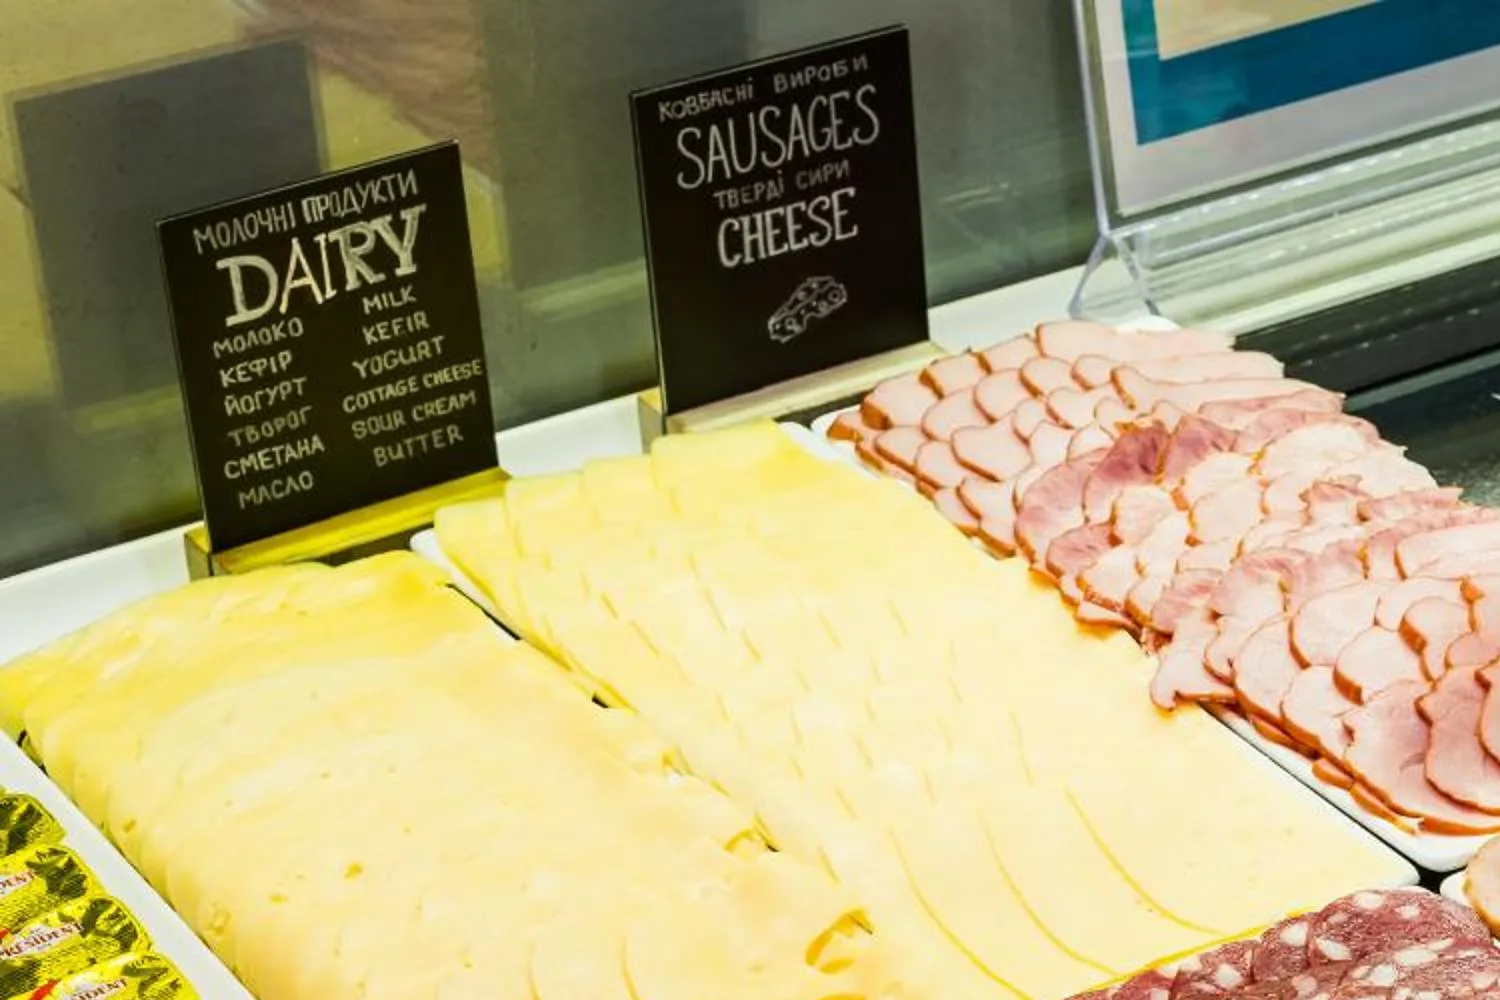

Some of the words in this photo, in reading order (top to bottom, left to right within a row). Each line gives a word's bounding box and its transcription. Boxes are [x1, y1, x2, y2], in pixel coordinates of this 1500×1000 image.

[773, 54, 868, 94] ВИРОБИ
[677, 85, 879, 189] SAUSAGES
[795, 160, 850, 191] СИРИ
[194, 202, 295, 254] МОЛОЧНІ
[302, 170, 419, 221] ПРОДУКТИ
[718, 187, 858, 268] CHEESE
[216, 204, 427, 326] DAIRY
[363, 284, 417, 313] MILK
[213, 317, 304, 358] МОЛОКО
[363, 311, 429, 344] KEFIR
[220, 351, 293, 388] КЕФІР
[353, 336, 446, 379] YOGURT
[424, 360, 481, 389] CHEESE
[224, 377, 307, 416] ЙОГУРТ
[352, 411, 406, 439] SOUR
[412, 390, 477, 422] CREAM
[228, 405, 313, 447] ТВОРОГ
[374, 425, 463, 467] BUTTER
[224, 435, 325, 479] СМЕТАНА
[239, 471, 313, 509] МАСЛО
